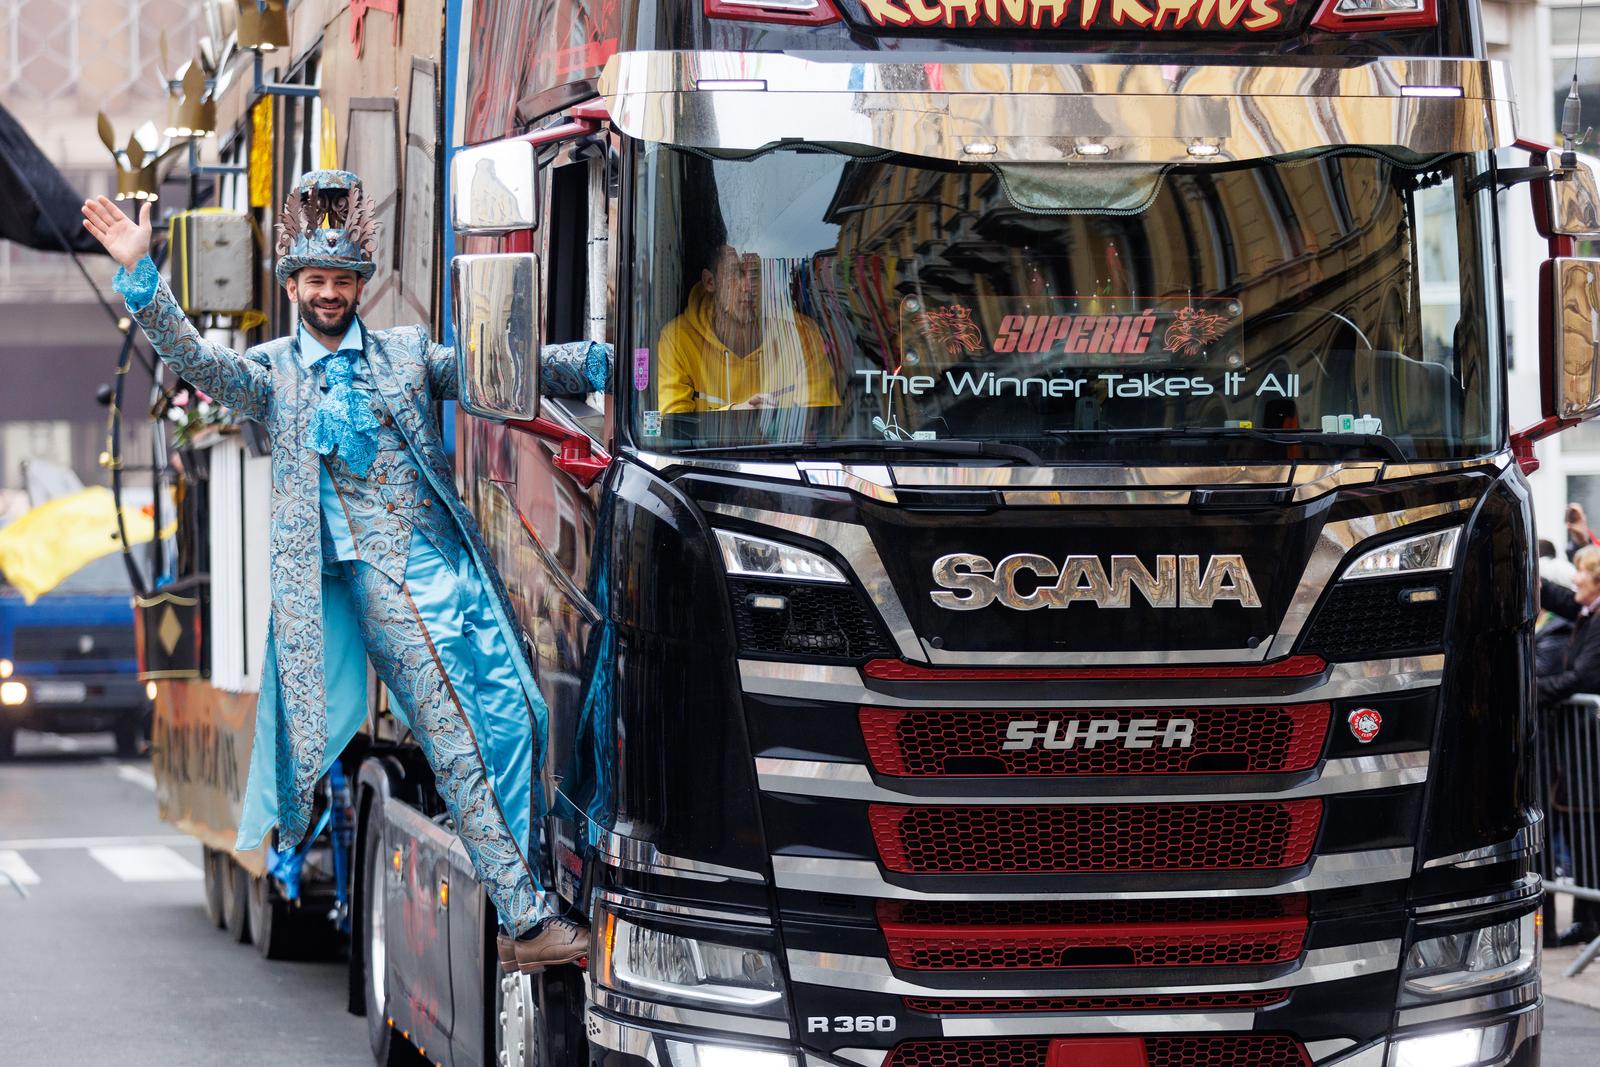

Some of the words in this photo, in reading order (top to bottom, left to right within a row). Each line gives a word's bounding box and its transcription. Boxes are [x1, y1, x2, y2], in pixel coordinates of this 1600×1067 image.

[993, 308, 1157, 353] SUPERIĆ
[855, 369, 935, 395] The
[945, 371, 1088, 398] Winner
[1098, 372, 1215, 399] Takes
[1224, 371, 1246, 396] It
[1255, 373, 1300, 398] All
[929, 553, 1263, 610] SCANIA
[1002, 718, 1195, 750] SUPER
[807, 1016, 830, 1033] R
[834, 1015, 897, 1033] 360
